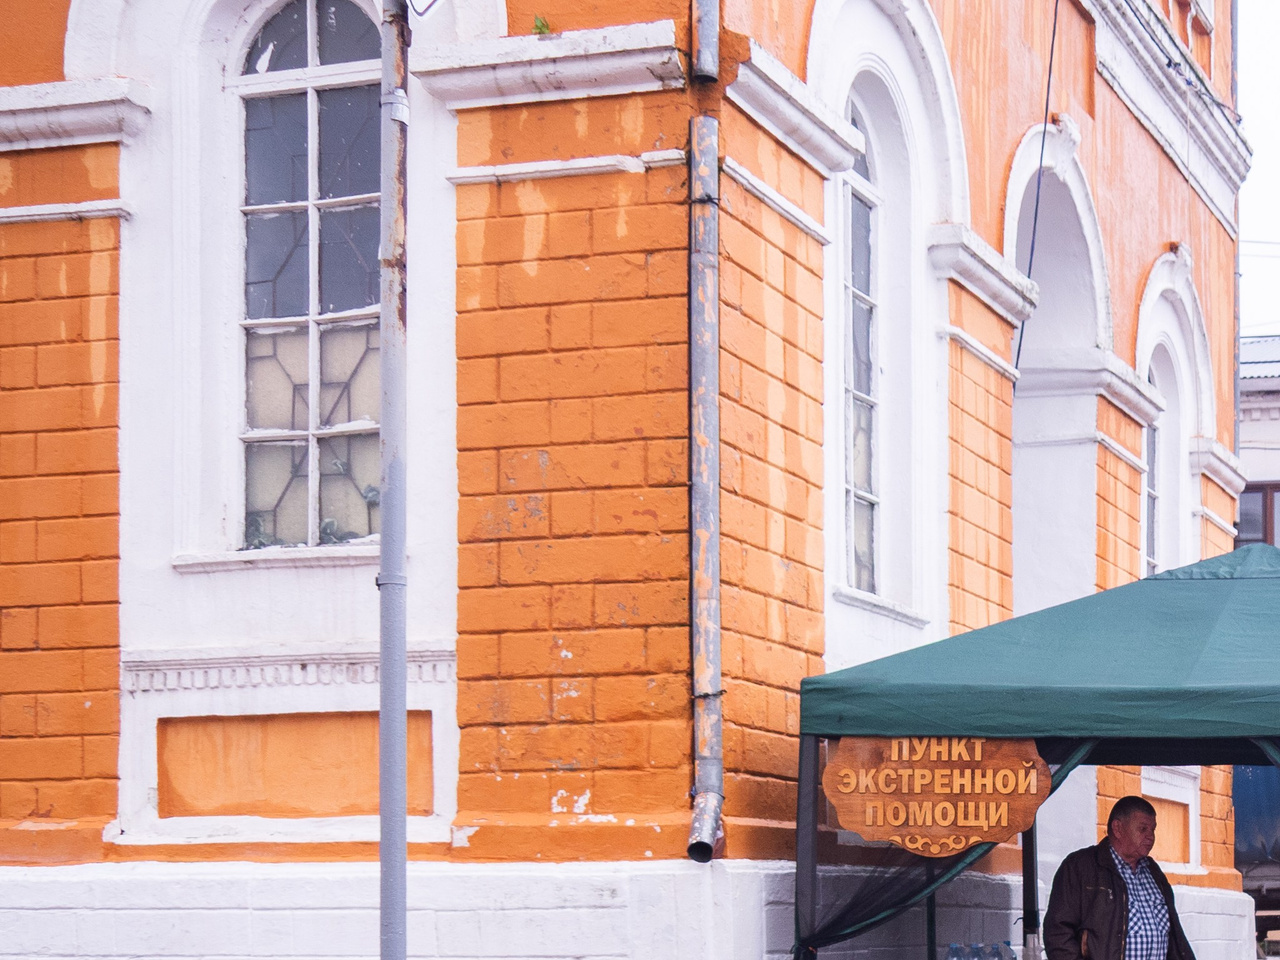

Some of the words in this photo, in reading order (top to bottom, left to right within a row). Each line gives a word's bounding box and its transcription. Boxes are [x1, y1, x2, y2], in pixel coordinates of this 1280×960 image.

[891, 737, 986, 762] ПУНКТ
[837, 761, 1038, 795] ЭКСТРЕННОЙ
[865, 801, 1009, 832] ПОМОЩИ
